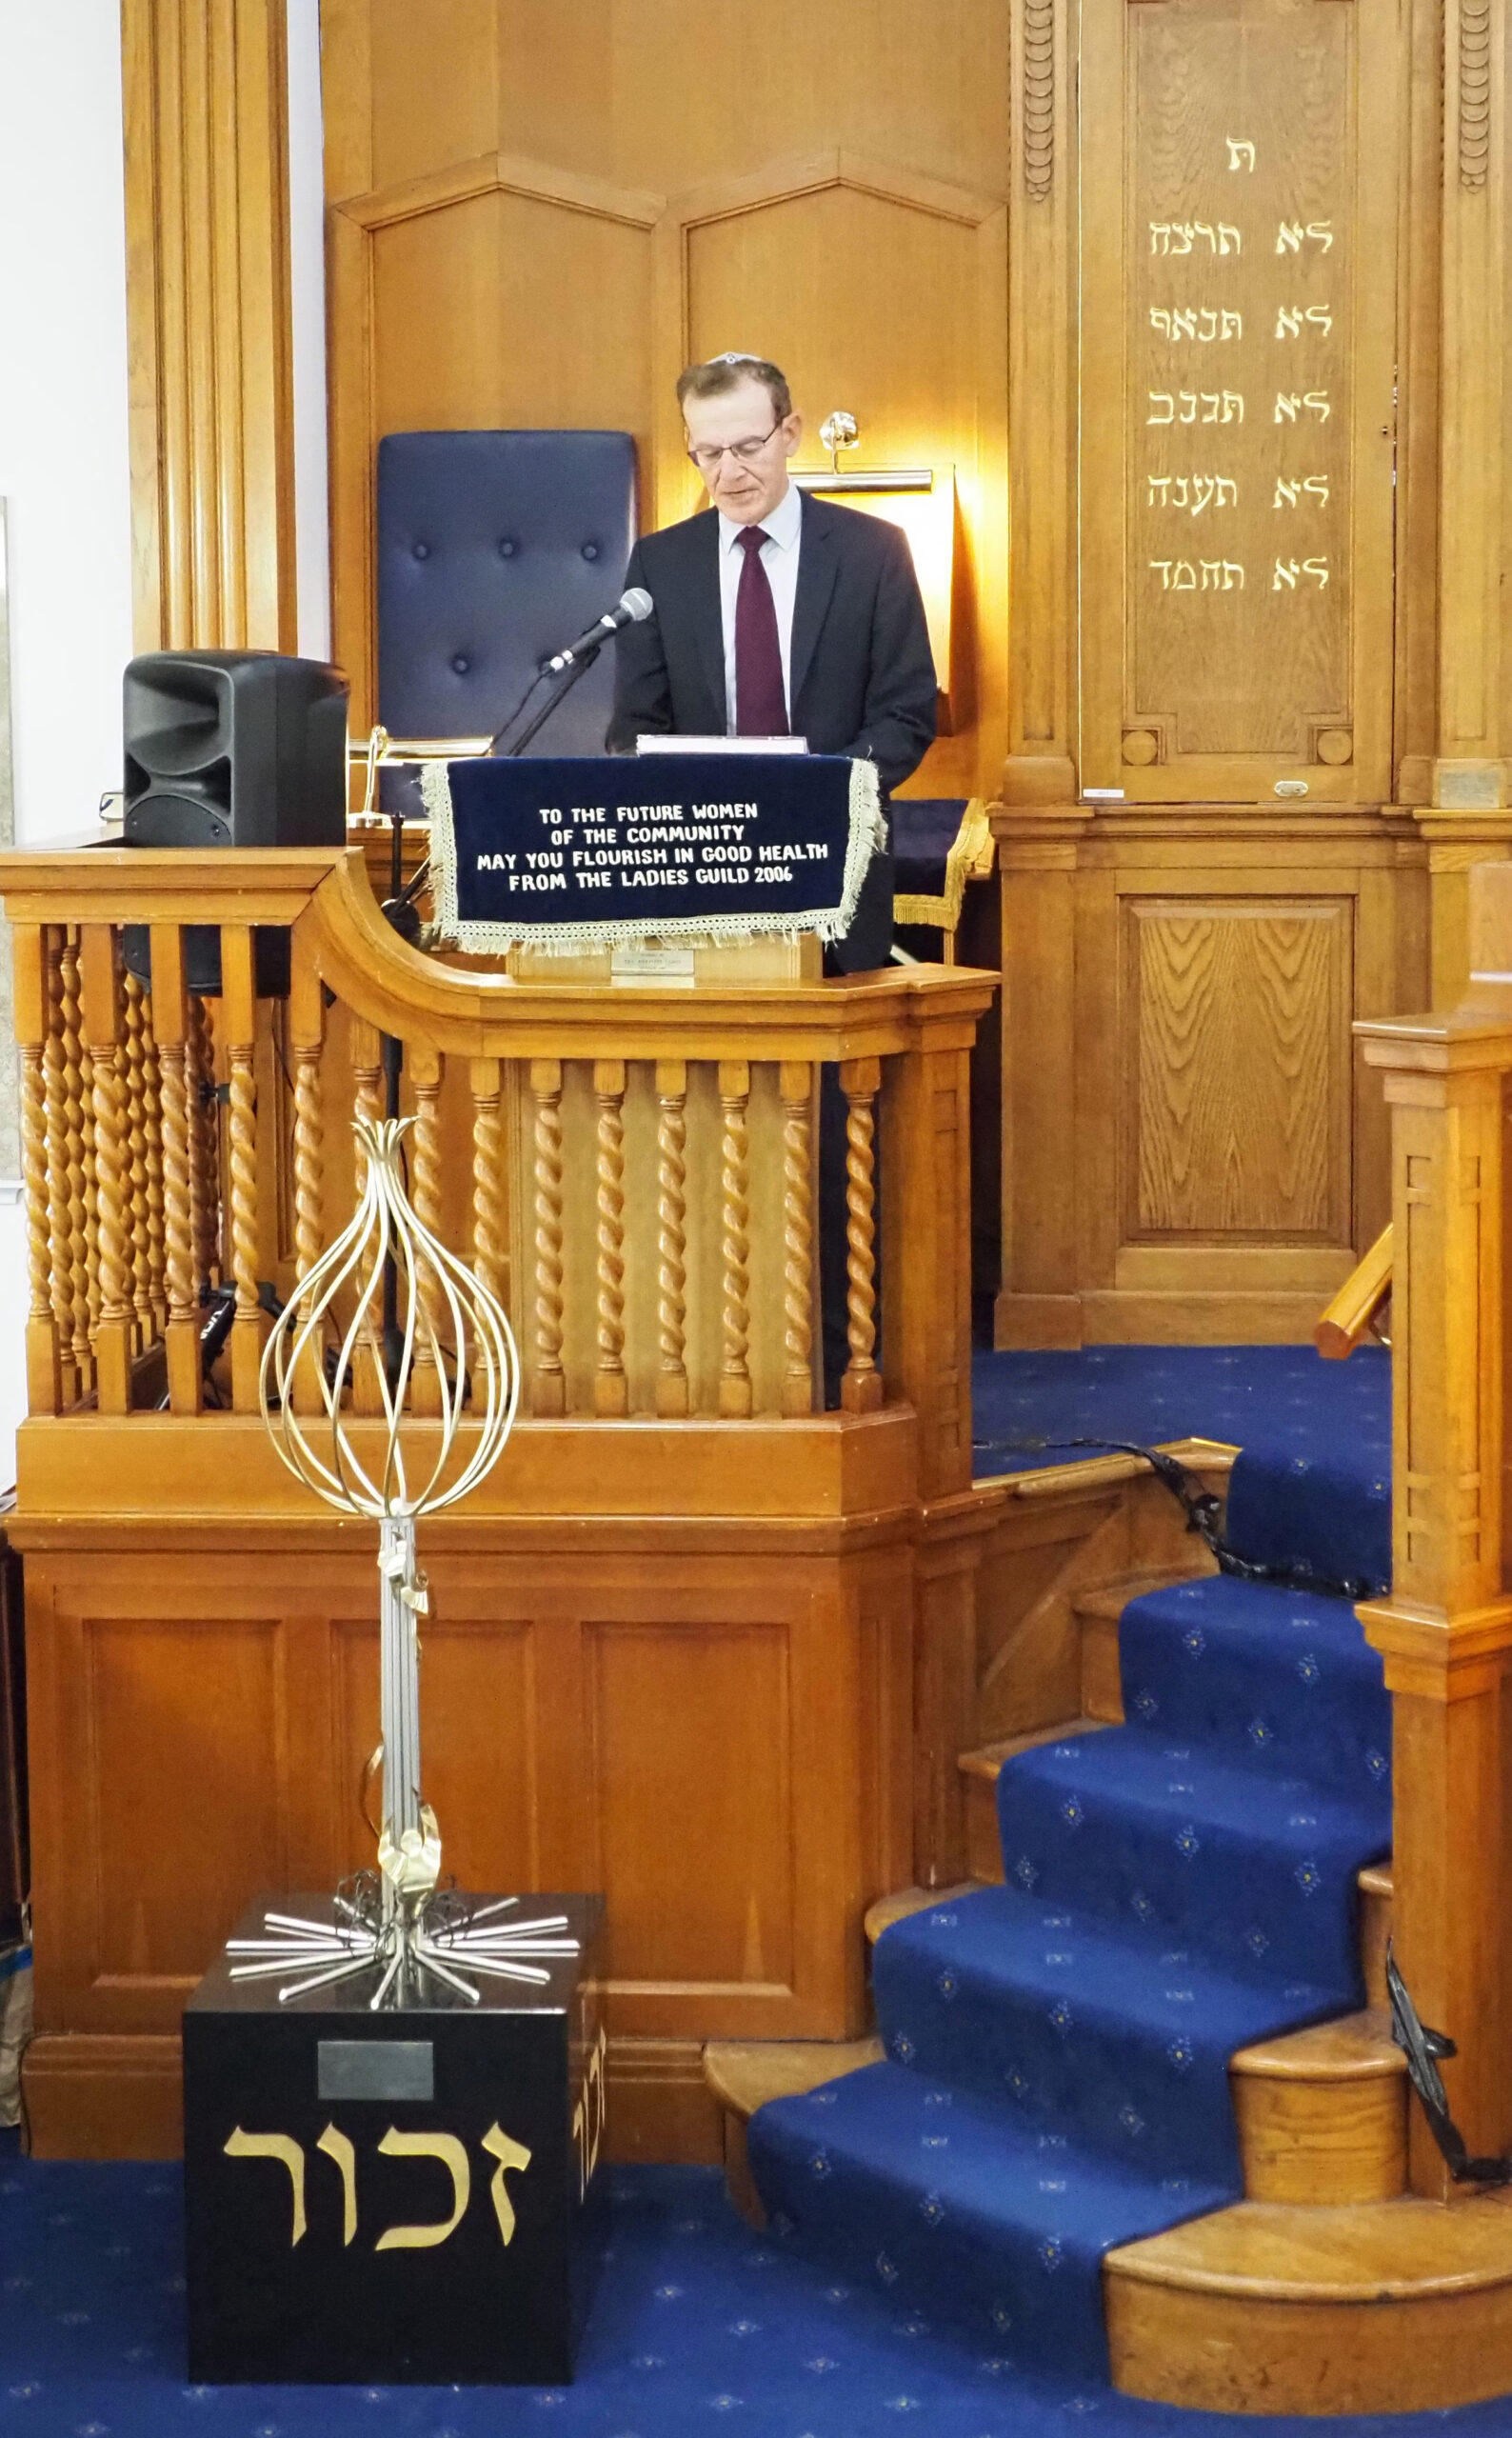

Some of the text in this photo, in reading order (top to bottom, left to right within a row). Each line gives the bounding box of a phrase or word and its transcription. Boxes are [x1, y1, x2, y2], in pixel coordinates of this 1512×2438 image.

[1149, 220, 1333, 255] לא תרצח
[1274, 304, 1332, 340] לא
[1273, 390, 1330, 424] לא
[1147, 473, 1329, 517] לא תענה
[1148, 556, 1329, 590] לא תחמד
[538, 803, 758, 825] TO THE FUTURE WOMEN
[550, 824, 746, 847] OF THE COMMUNITY
[476, 843, 828, 871] MAY YOU FLOURISH IN GOOD HEALTH
[508, 865, 793, 891] FROM THE LADIES GUILD 2006
[223, 2120, 532, 2251] זכור
